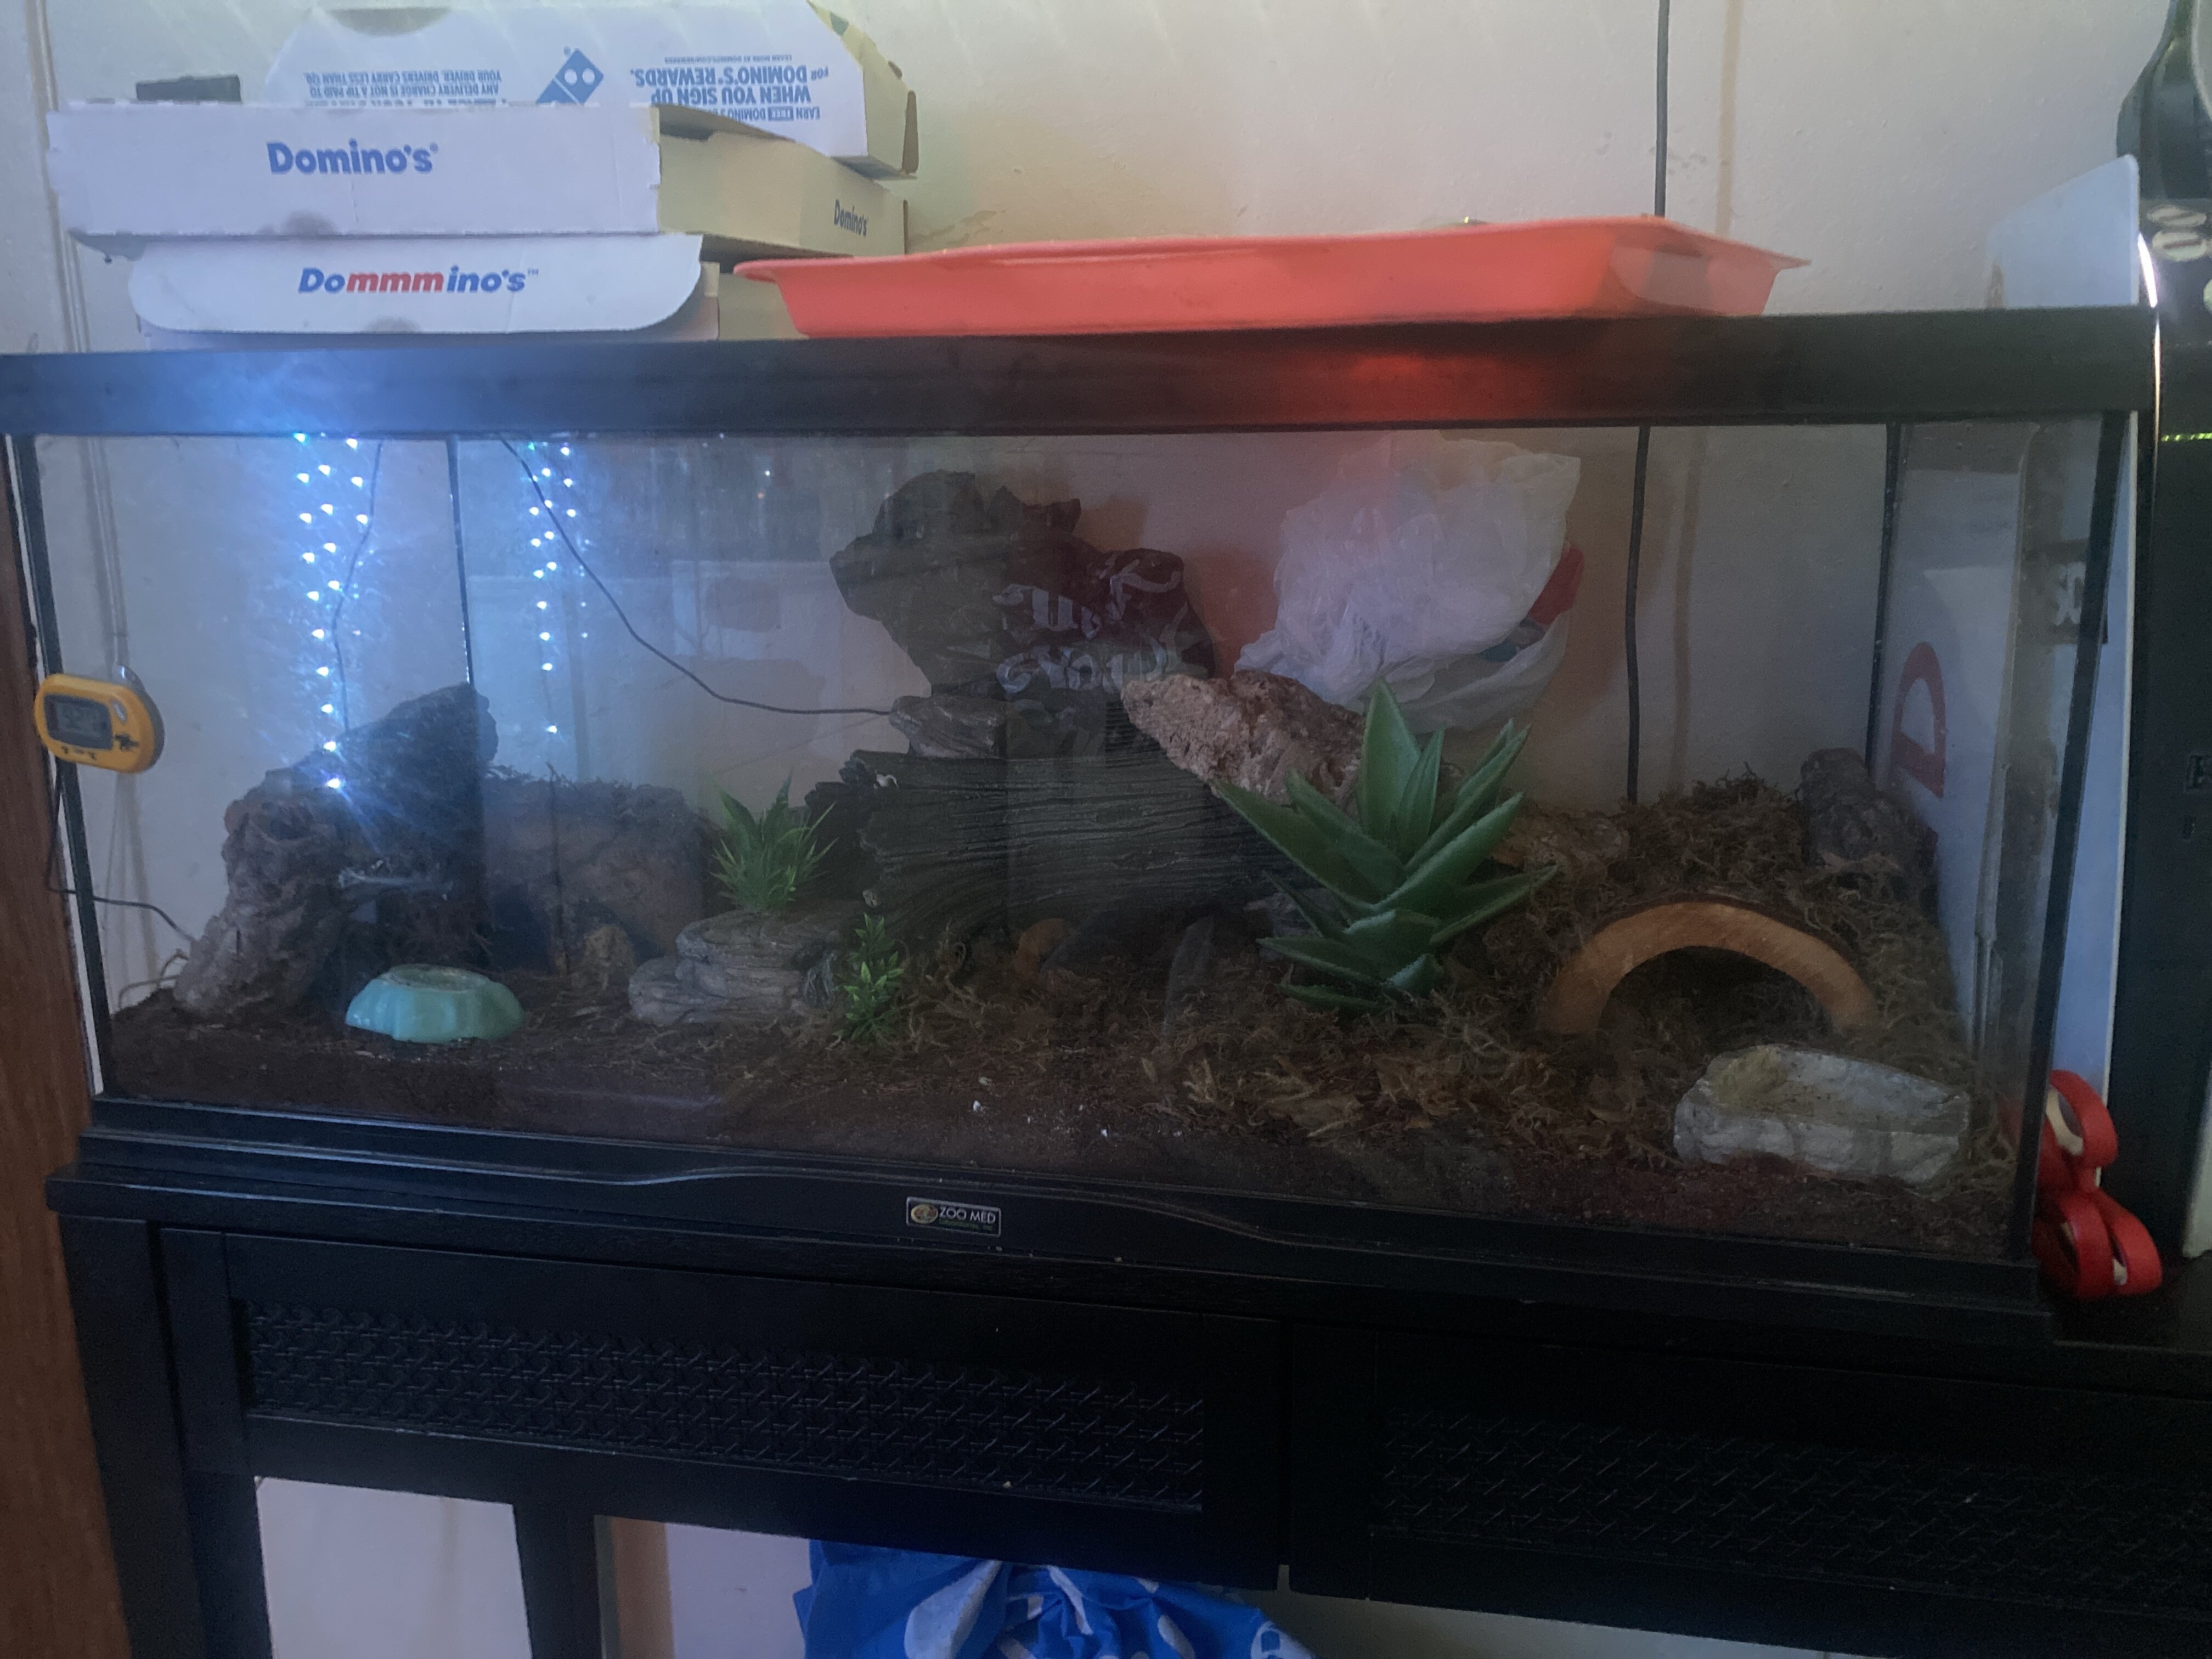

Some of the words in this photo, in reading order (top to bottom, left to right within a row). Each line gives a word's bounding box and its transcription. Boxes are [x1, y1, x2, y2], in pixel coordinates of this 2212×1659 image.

[478, 70, 501, 82] YOUR
[630, 66, 716, 87] REWARDS.
[811, 65, 829, 81] FOR
[438, 85, 479, 95] DELIVERY
[482, 84, 499, 95] ANY
[651, 88, 673, 103] UP
[677, 87, 718, 105] SIGN
[721, 87, 757, 104] YOU
[760, 85, 811, 104] WHEN
[795, 107, 820, 121] EARN
[939, 1206, 967, 1220] ZOO
[970, 1210, 996, 1223] MED
